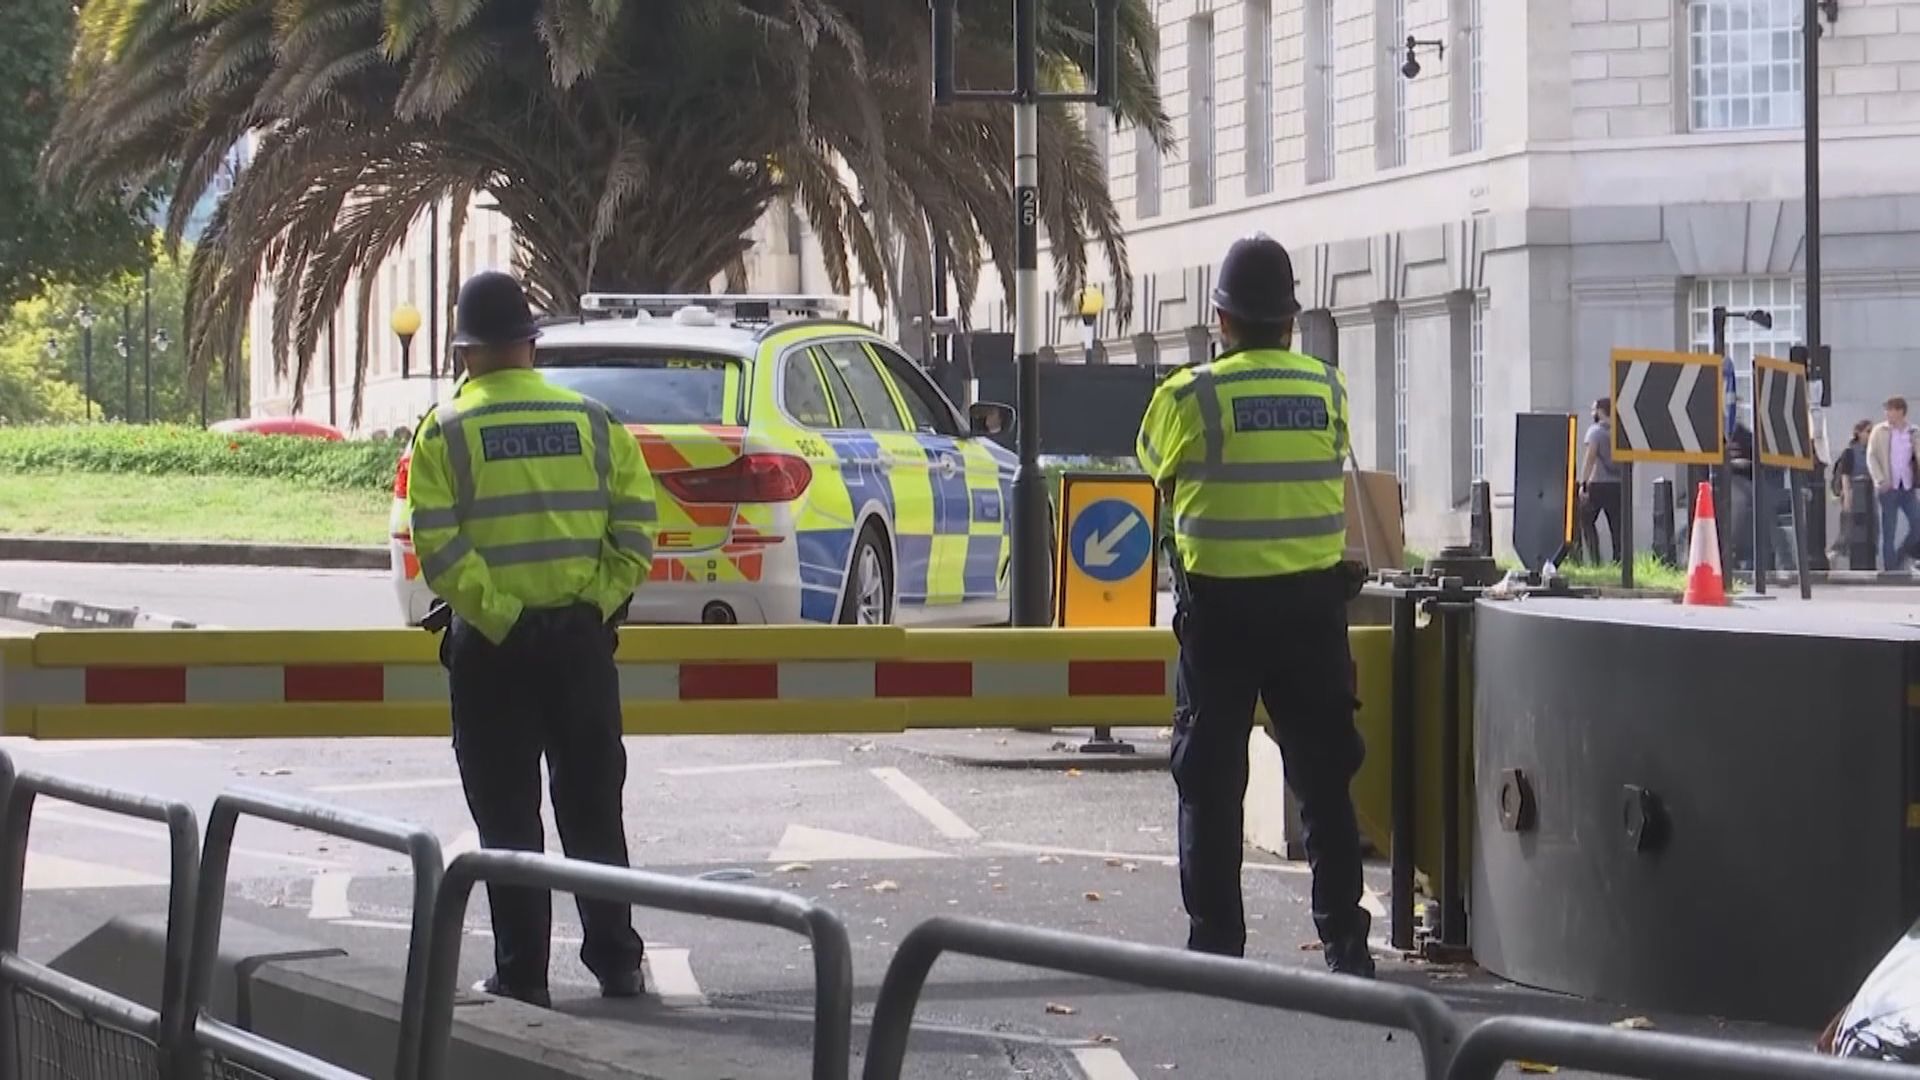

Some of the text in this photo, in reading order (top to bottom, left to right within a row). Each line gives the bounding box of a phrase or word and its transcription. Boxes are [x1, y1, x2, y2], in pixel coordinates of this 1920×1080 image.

[1023, 190, 1034, 225] 25
[1237, 409, 1326, 428] POLICE
[486, 434, 580, 459] POLICE
